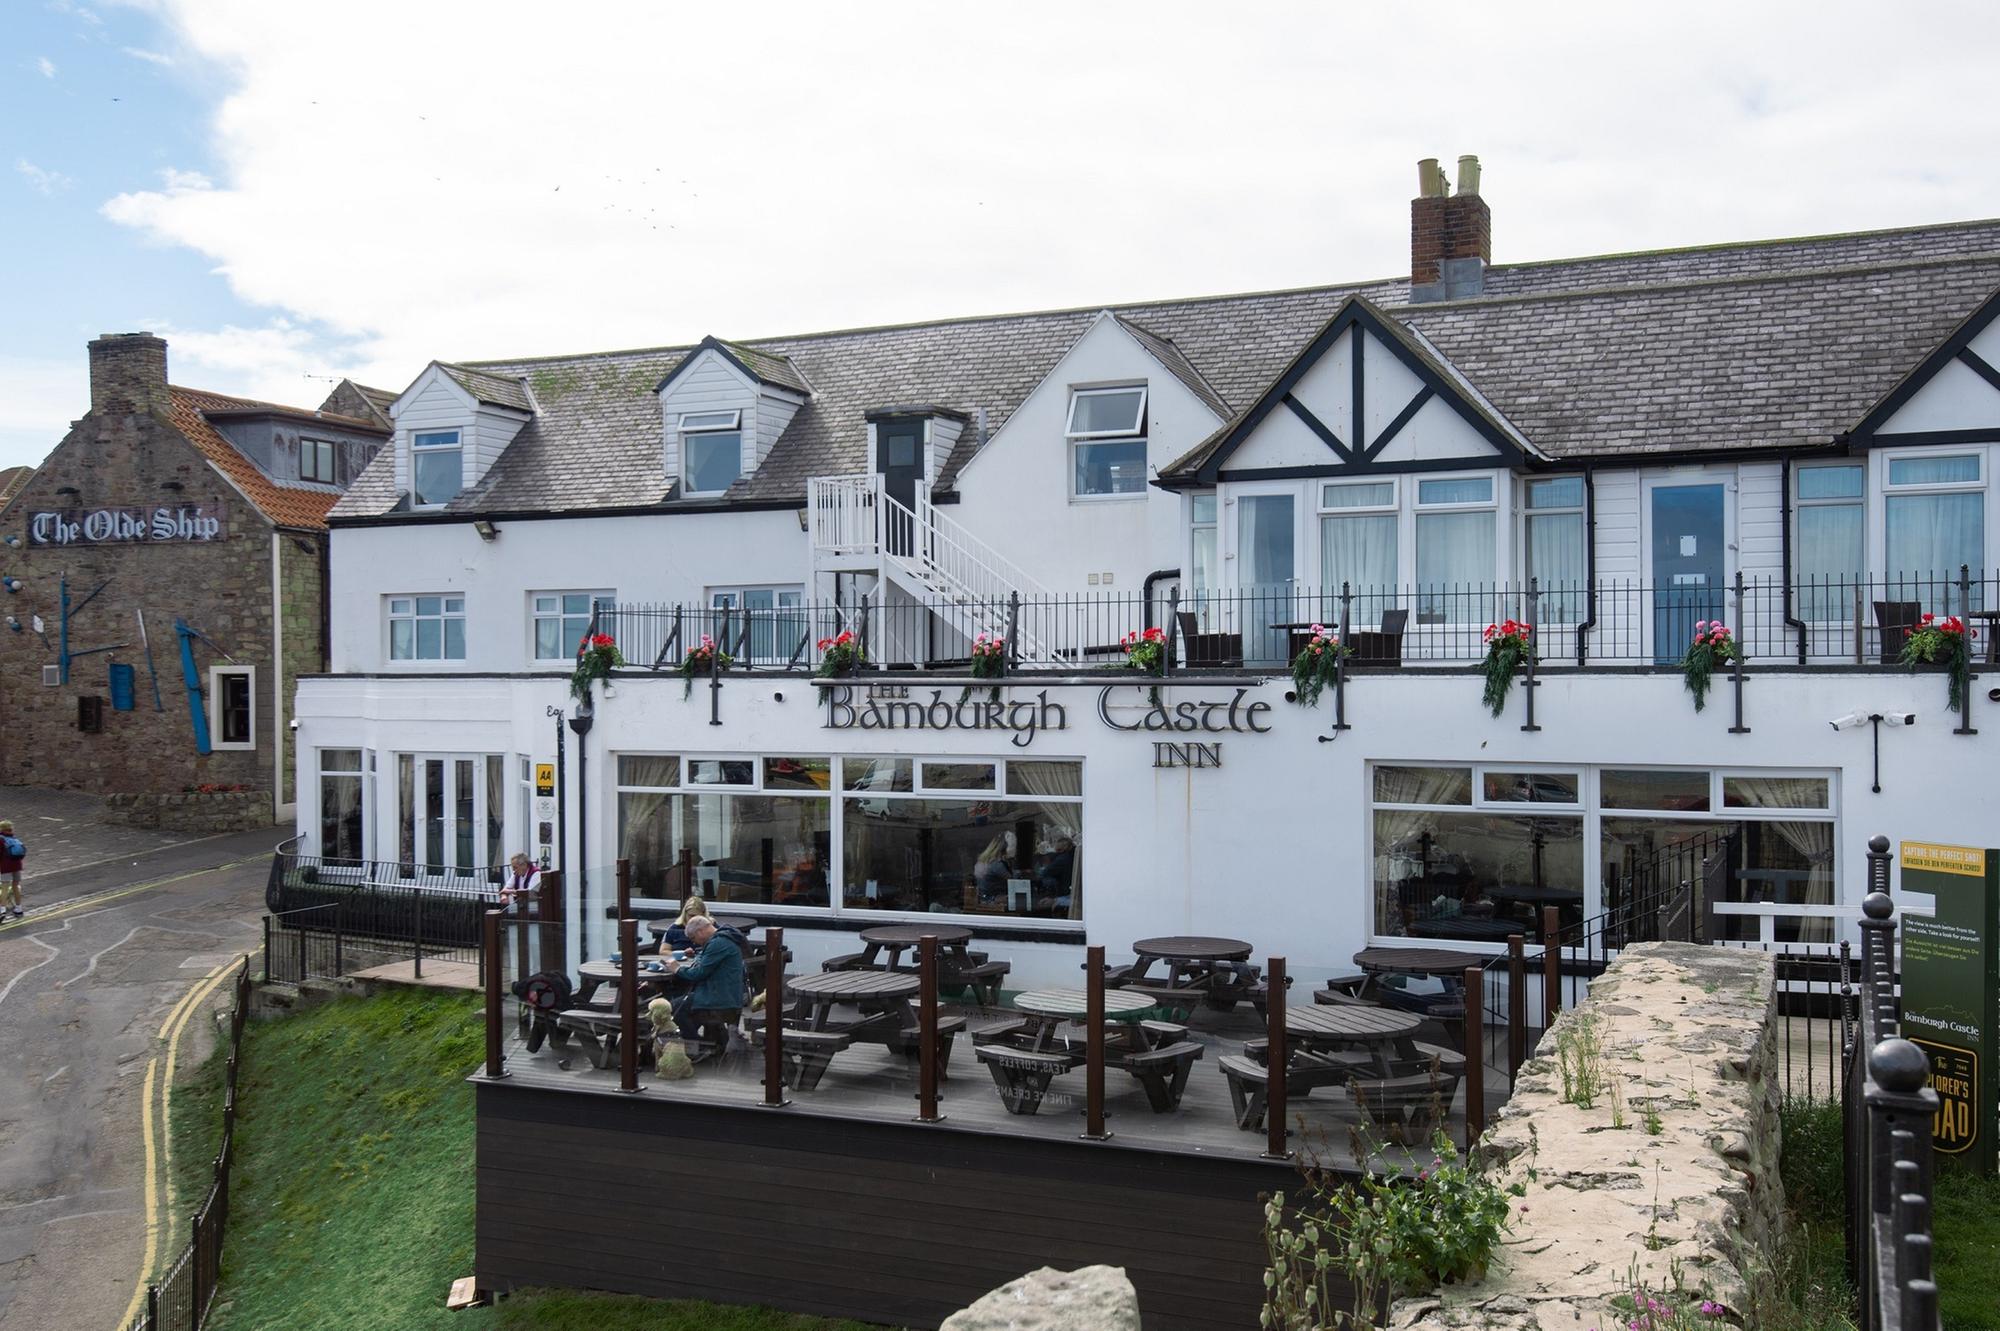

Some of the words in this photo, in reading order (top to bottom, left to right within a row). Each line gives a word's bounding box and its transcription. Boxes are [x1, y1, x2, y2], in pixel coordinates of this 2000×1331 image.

[33, 512, 79, 545] The
[85, 510, 147, 541] Olde
[151, 507, 220, 542] Ship
[820, 686, 1071, 747] Bamburgh
[1097, 686, 1272, 733] Castle
[1152, 742, 1223, 769] INN
[540, 770, 552, 781] AA
[1903, 846, 1928, 858] CAPTURE
[1930, 848, 1938, 859] THE
[1940, 849, 1964, 861] PERFECT
[1941, 924, 1956, 932] better
[1956, 926, 1967, 934] from
[1904, 1011, 1949, 1030] Bamburgh
[1950, 1021, 1980, 1036] Castle
